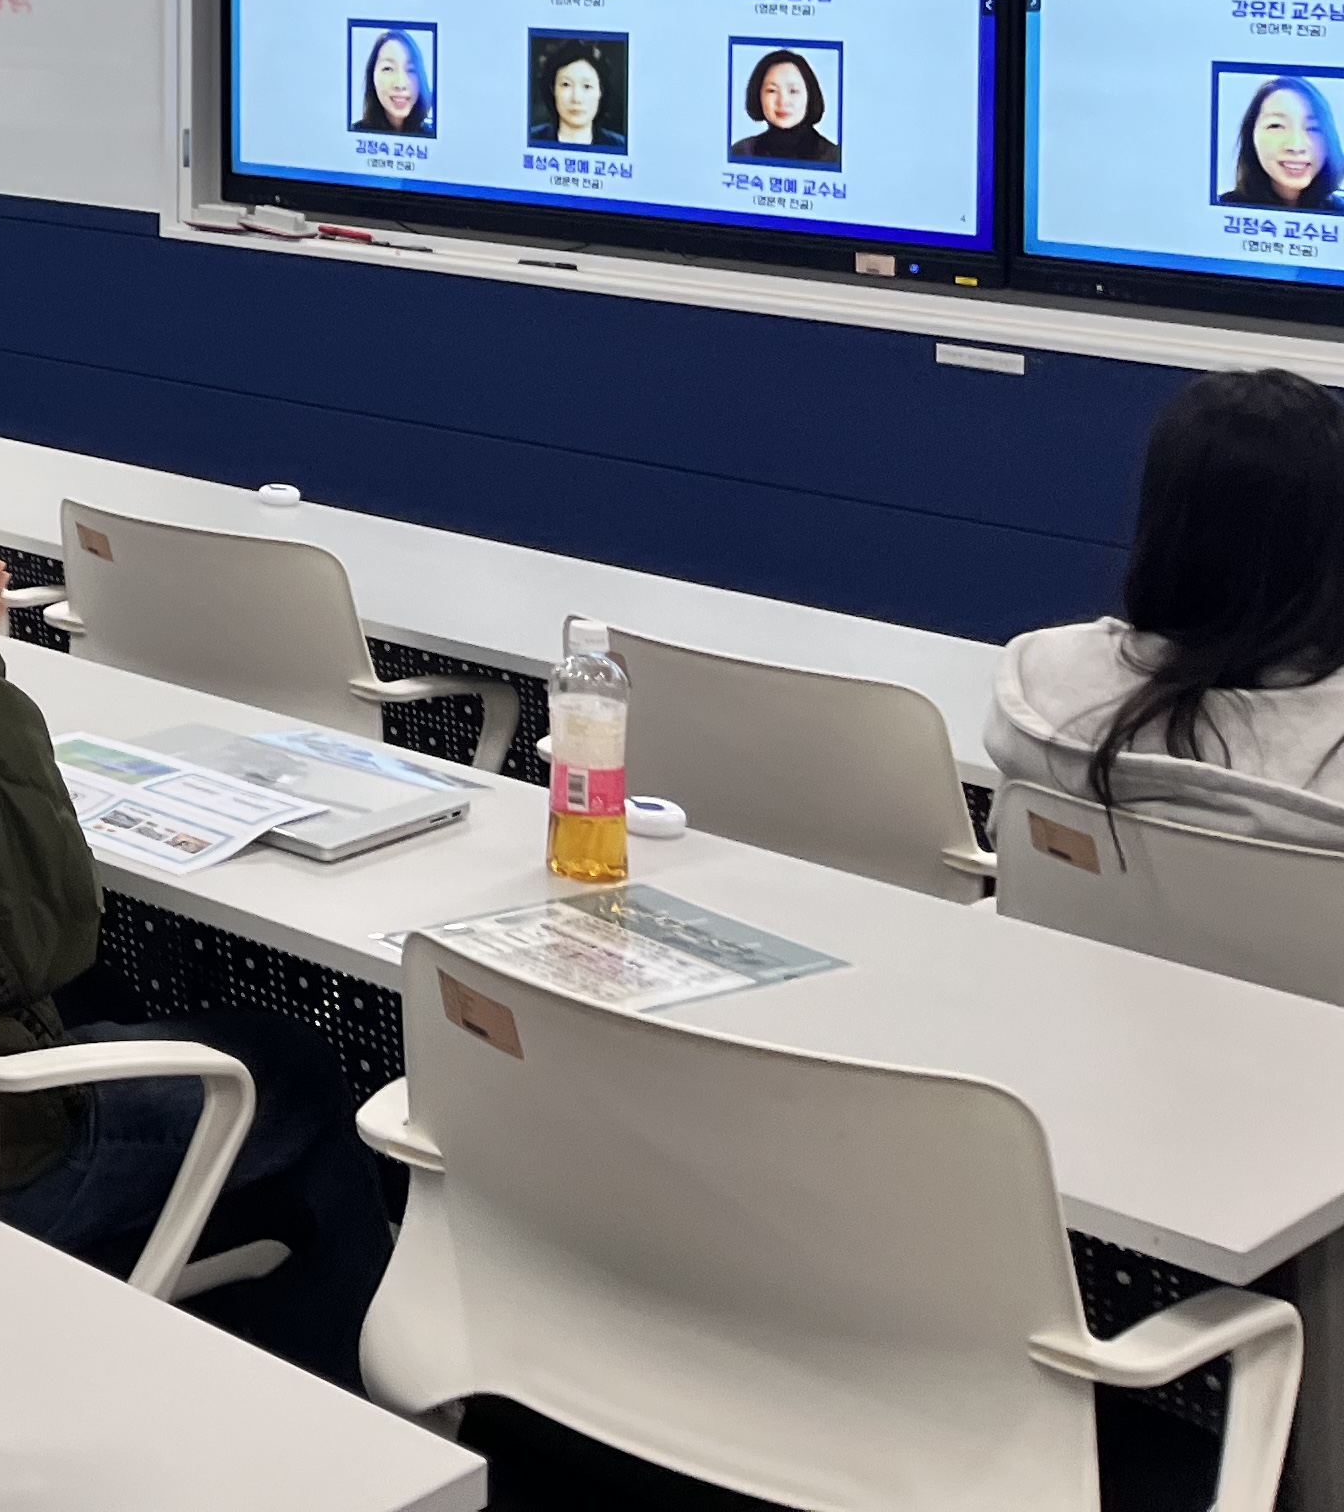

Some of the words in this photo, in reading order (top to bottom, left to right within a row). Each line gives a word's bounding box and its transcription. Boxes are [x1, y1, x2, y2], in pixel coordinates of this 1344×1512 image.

[1232, 0, 1285, 19] 강유진
[356, 140, 390, 156] 김정숙
[393, 143, 428, 159] 교수님
[564, 157, 590, 174] 명예
[594, 160, 633, 179] 교수님
[722, 172, 764, 191] 구은숙
[769, 176, 797, 194] 명예
[803, 179, 847, 199] 교수님
[1224, 215, 1277, 237] 김정숙
[1284, 220, 1338, 243] 교수님
